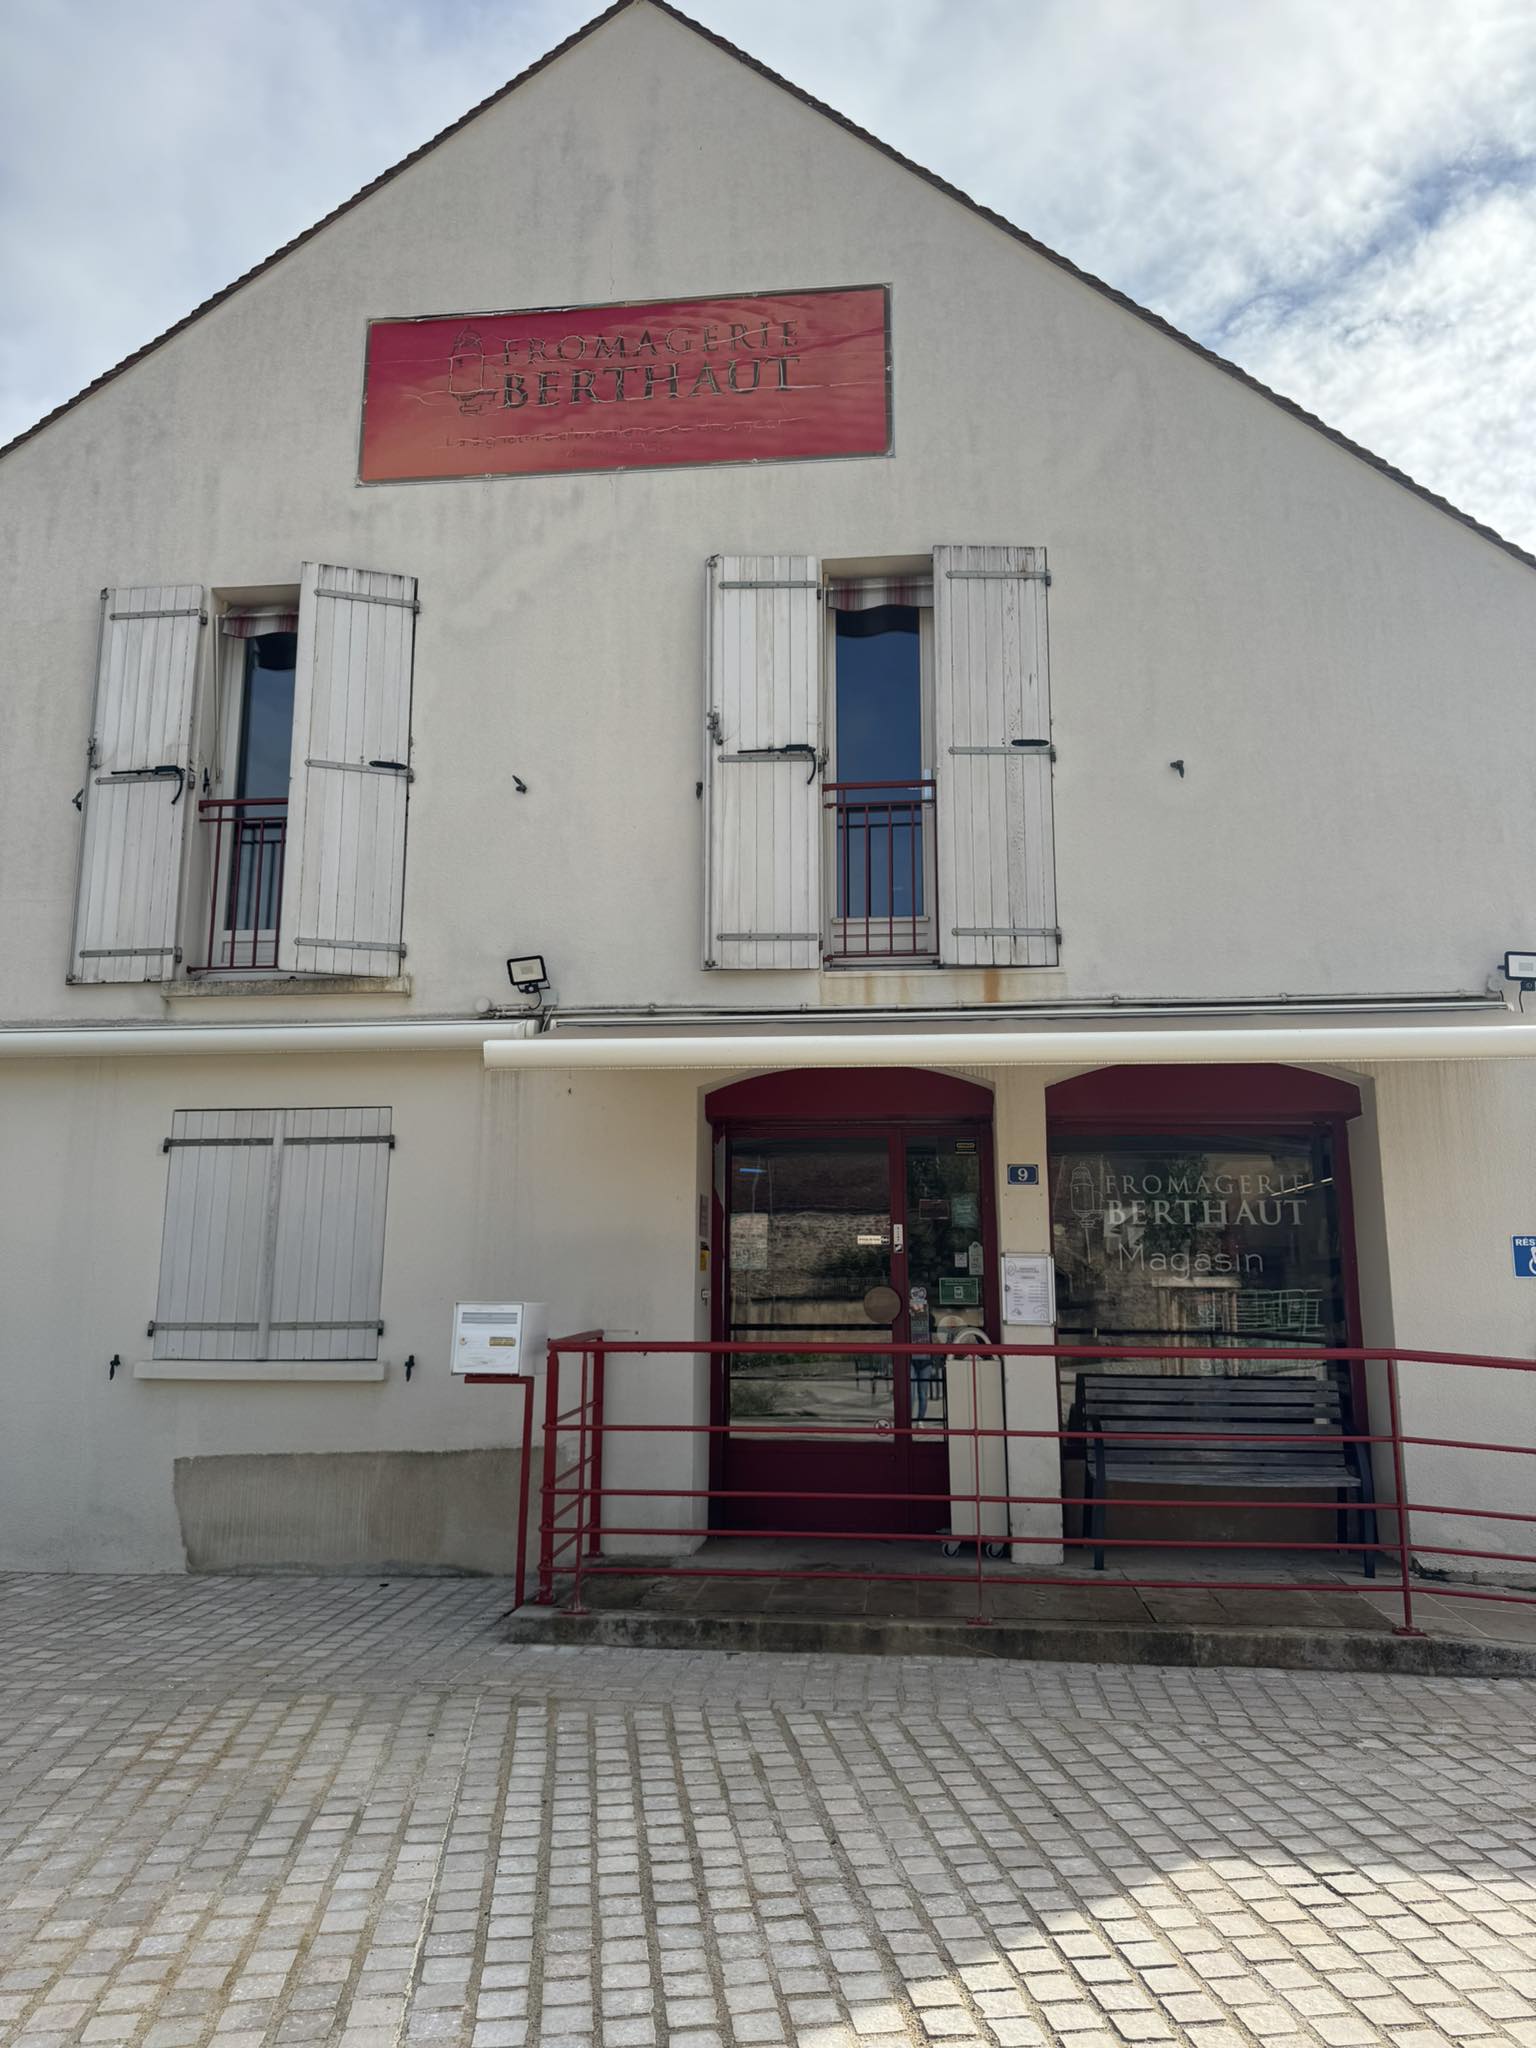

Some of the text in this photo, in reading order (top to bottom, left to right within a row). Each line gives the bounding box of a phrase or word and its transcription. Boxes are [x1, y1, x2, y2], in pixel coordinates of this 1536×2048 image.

[502, 320, 798, 366] FROMAGERIE
[500, 355, 800, 409] BERTHAUT
[1017, 1167, 1028, 1181] 9
[1106, 1174, 1306, 1195] FROMAGERIE
[1107, 1200, 1307, 1226] BERTHAUT
[1118, 1244, 1264, 1281] Magasin
